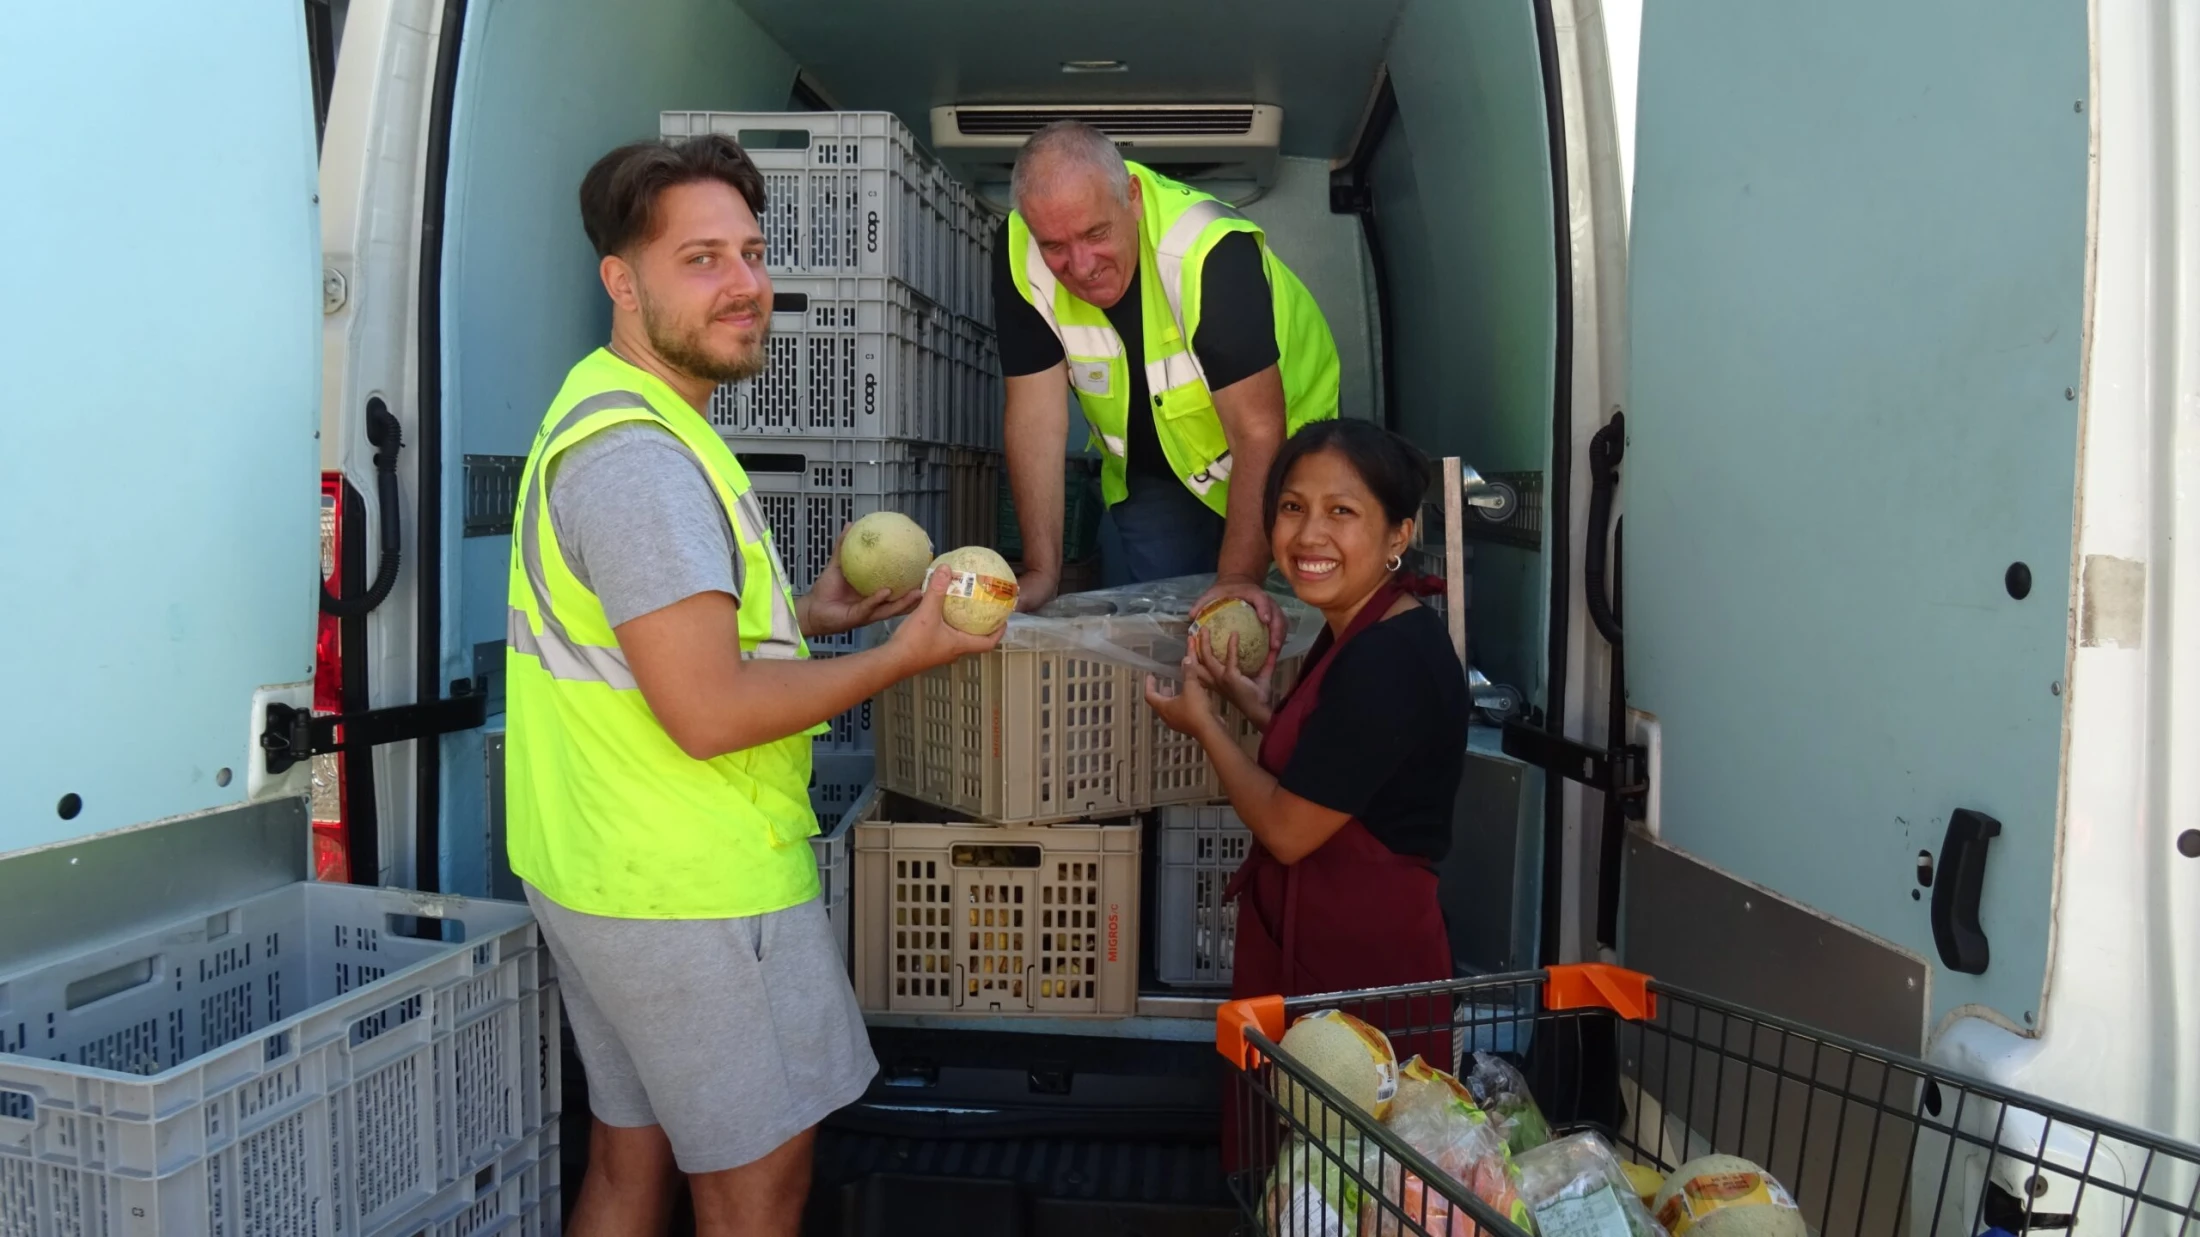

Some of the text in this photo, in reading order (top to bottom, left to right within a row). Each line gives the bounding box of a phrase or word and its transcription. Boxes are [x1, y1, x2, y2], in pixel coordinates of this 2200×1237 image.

[868, 211, 880, 253] coop
[865, 373, 877, 415] coop
[132, 1207, 145, 1218] C3
